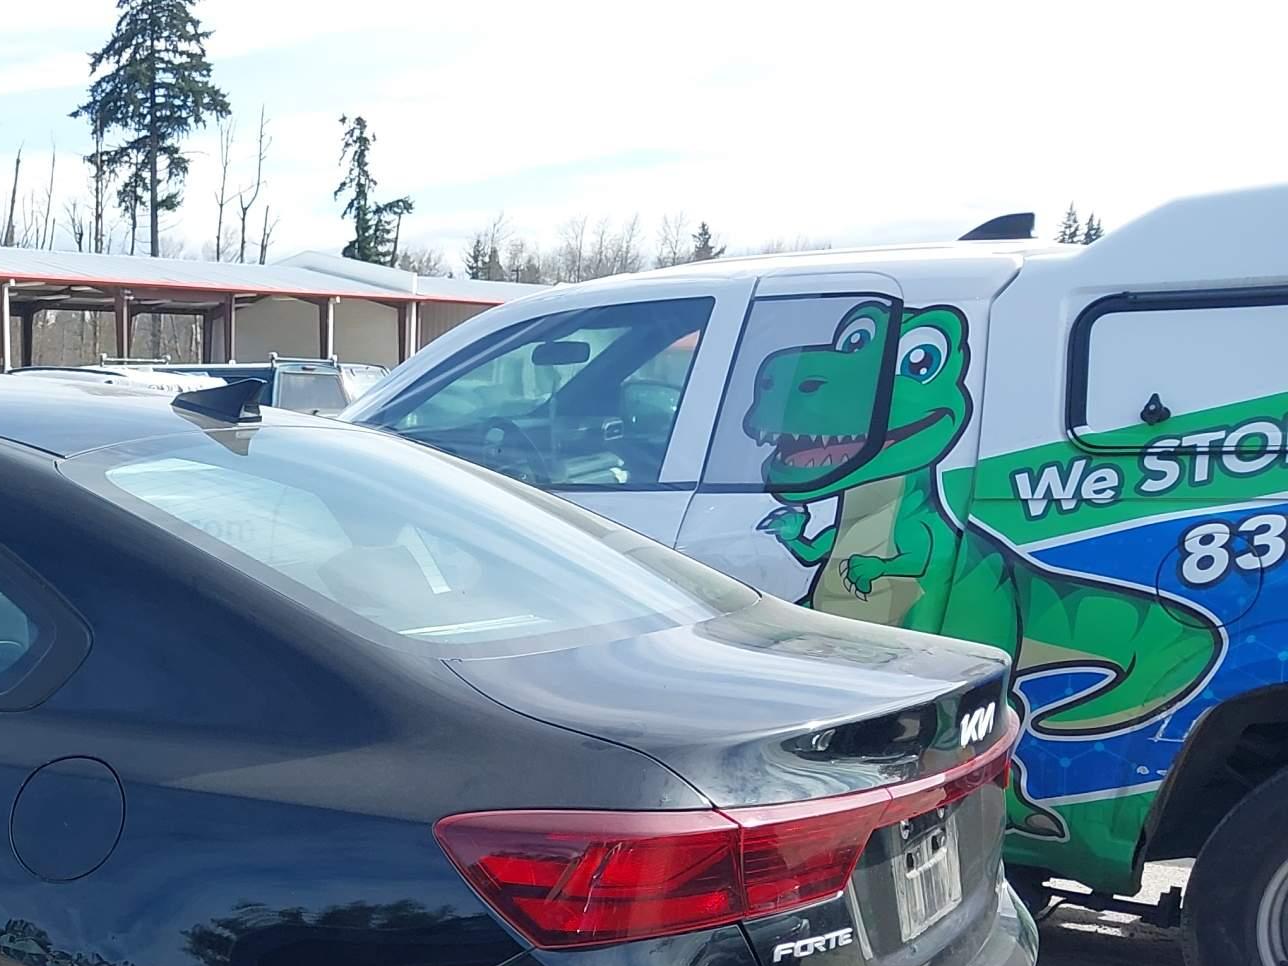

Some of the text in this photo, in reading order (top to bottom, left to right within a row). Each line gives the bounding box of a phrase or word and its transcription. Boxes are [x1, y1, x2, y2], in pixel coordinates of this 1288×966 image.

[1014, 420, 1288, 518] We STO
[1182, 513, 1288, 585] 83
[773, 927, 853, 963] FORTE
